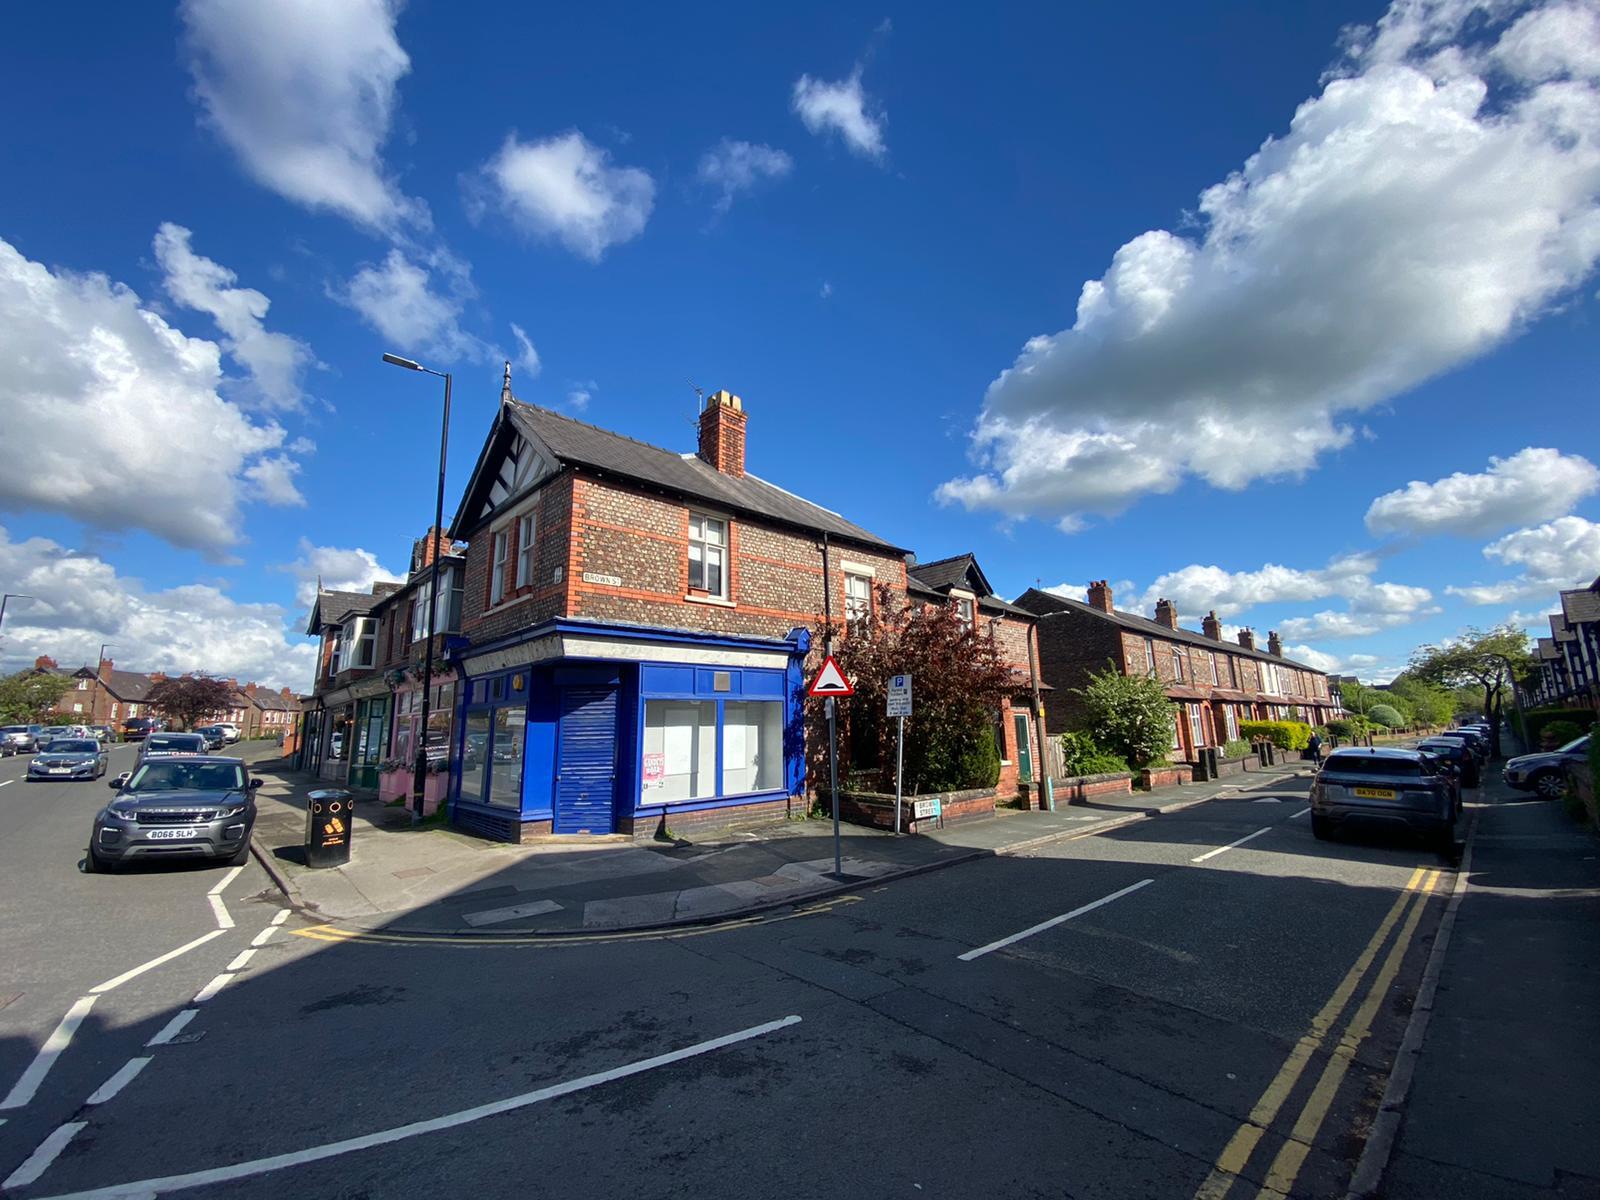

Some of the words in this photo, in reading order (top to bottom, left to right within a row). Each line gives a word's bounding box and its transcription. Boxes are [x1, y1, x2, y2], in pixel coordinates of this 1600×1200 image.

[584, 573, 611, 584] BROWN
[896, 677, 903, 687] P
[175, 829, 193, 838] SLH
